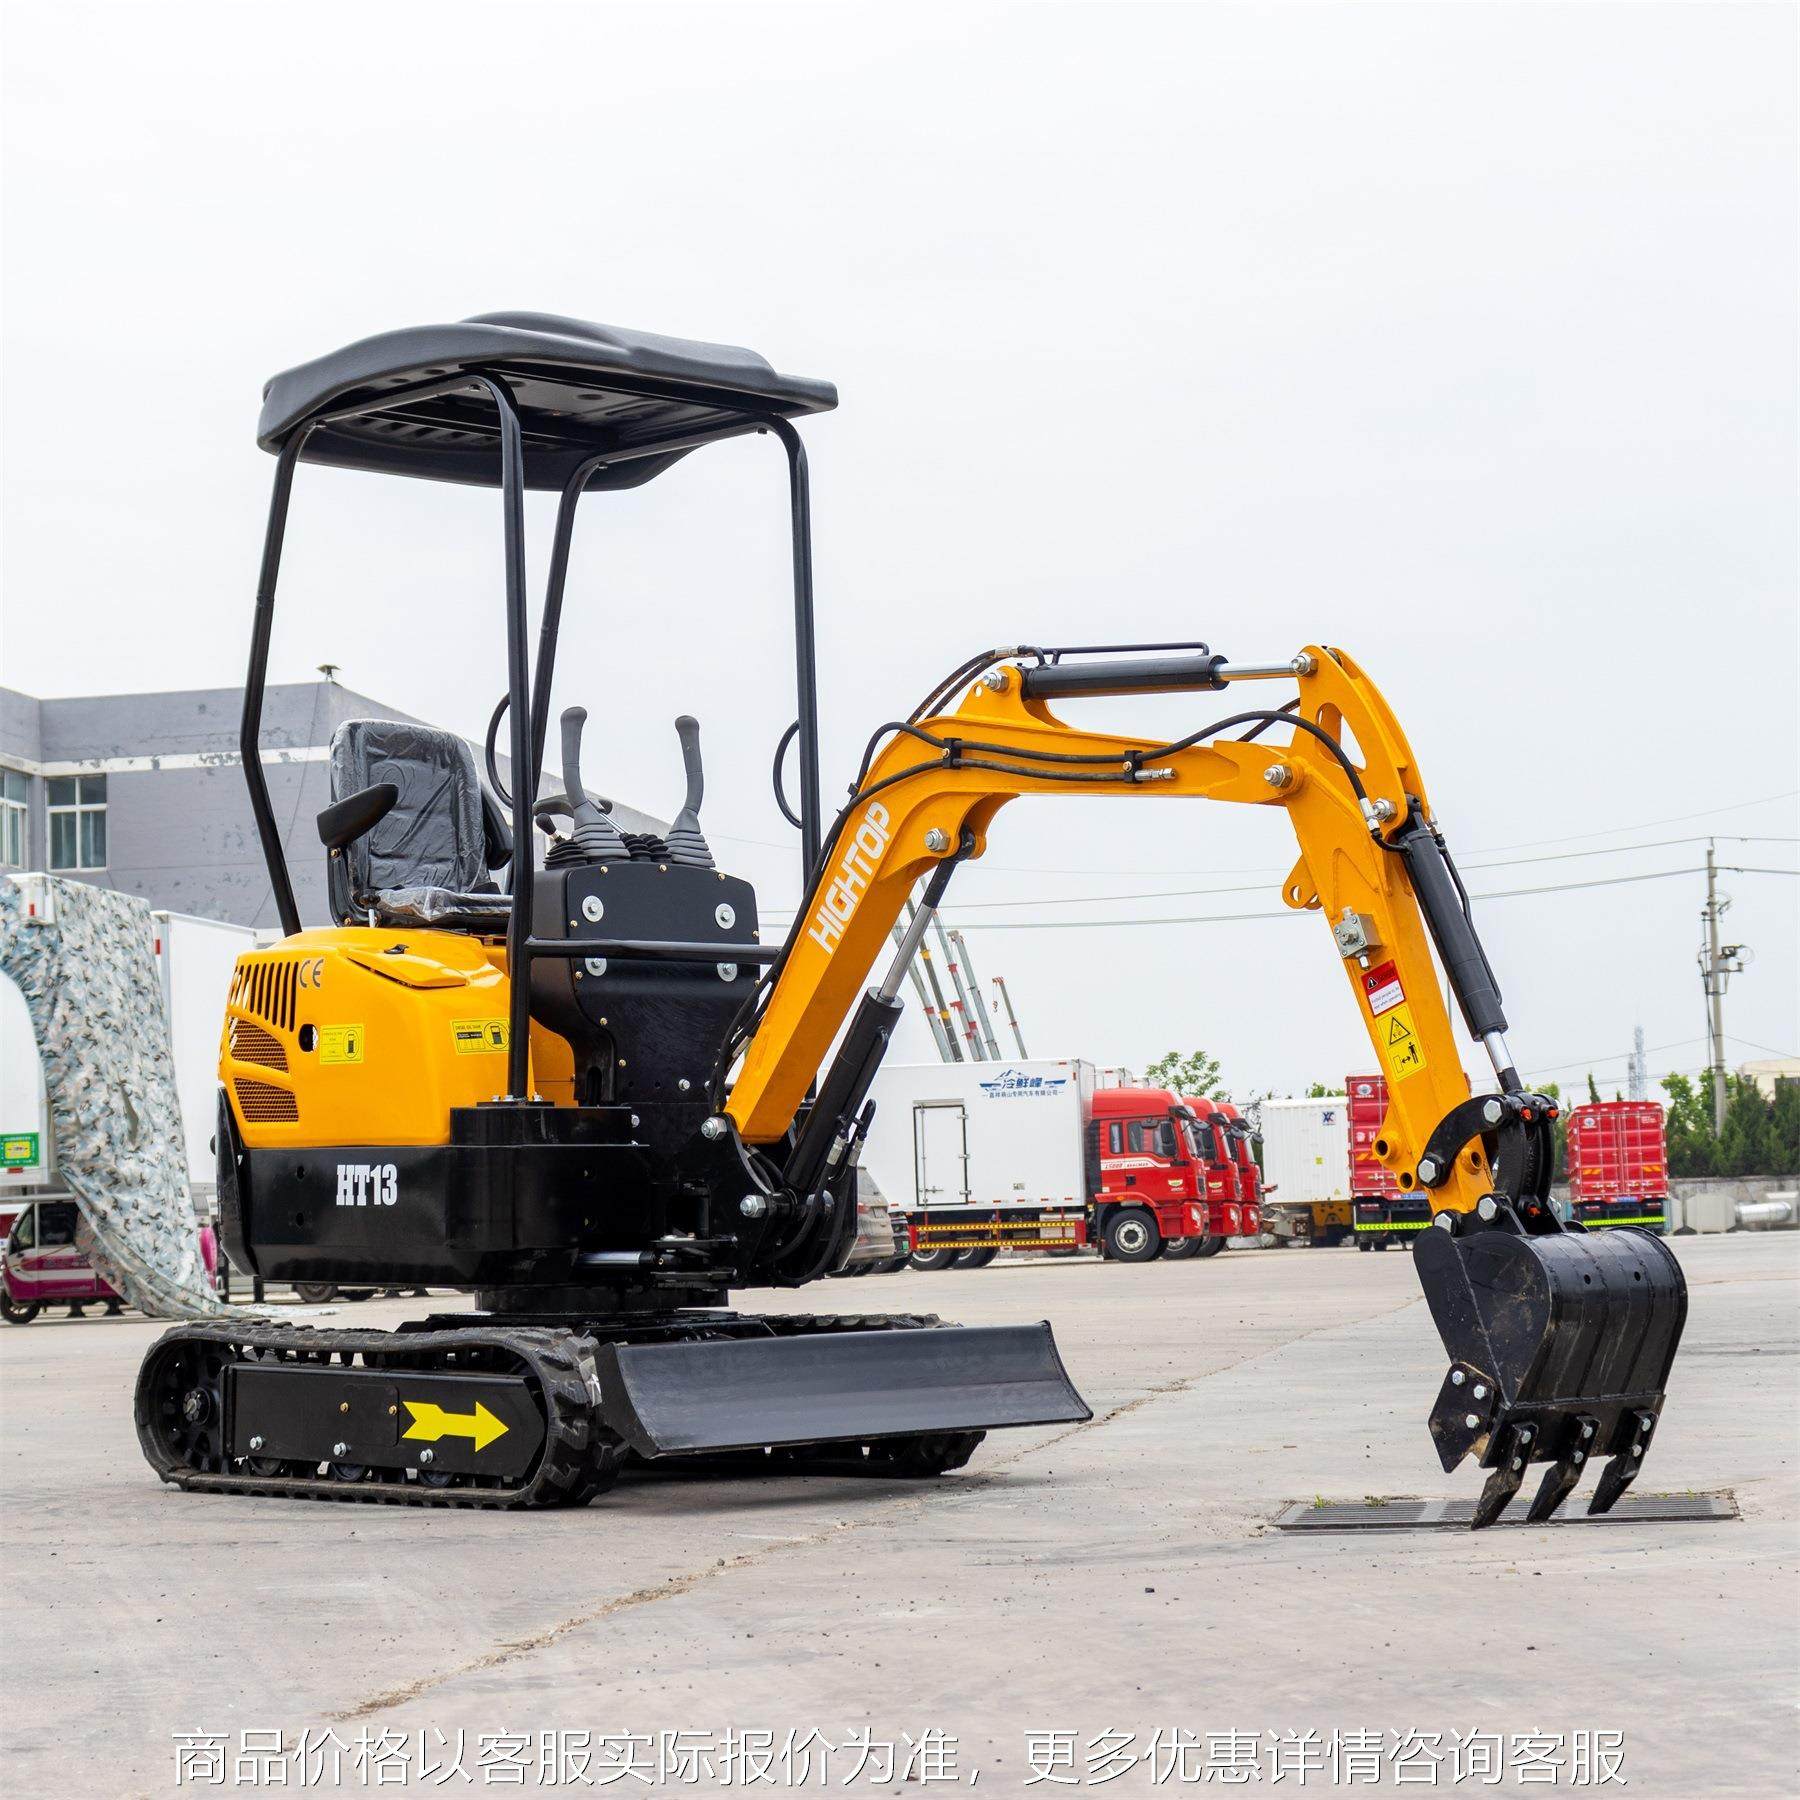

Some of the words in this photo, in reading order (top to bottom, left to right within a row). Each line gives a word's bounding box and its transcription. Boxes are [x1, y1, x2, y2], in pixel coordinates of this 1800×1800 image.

[808, 801, 890, 955] HIGHTOP
[299, 959, 324, 988] CE
[336, 1163, 398, 1206] HT13
